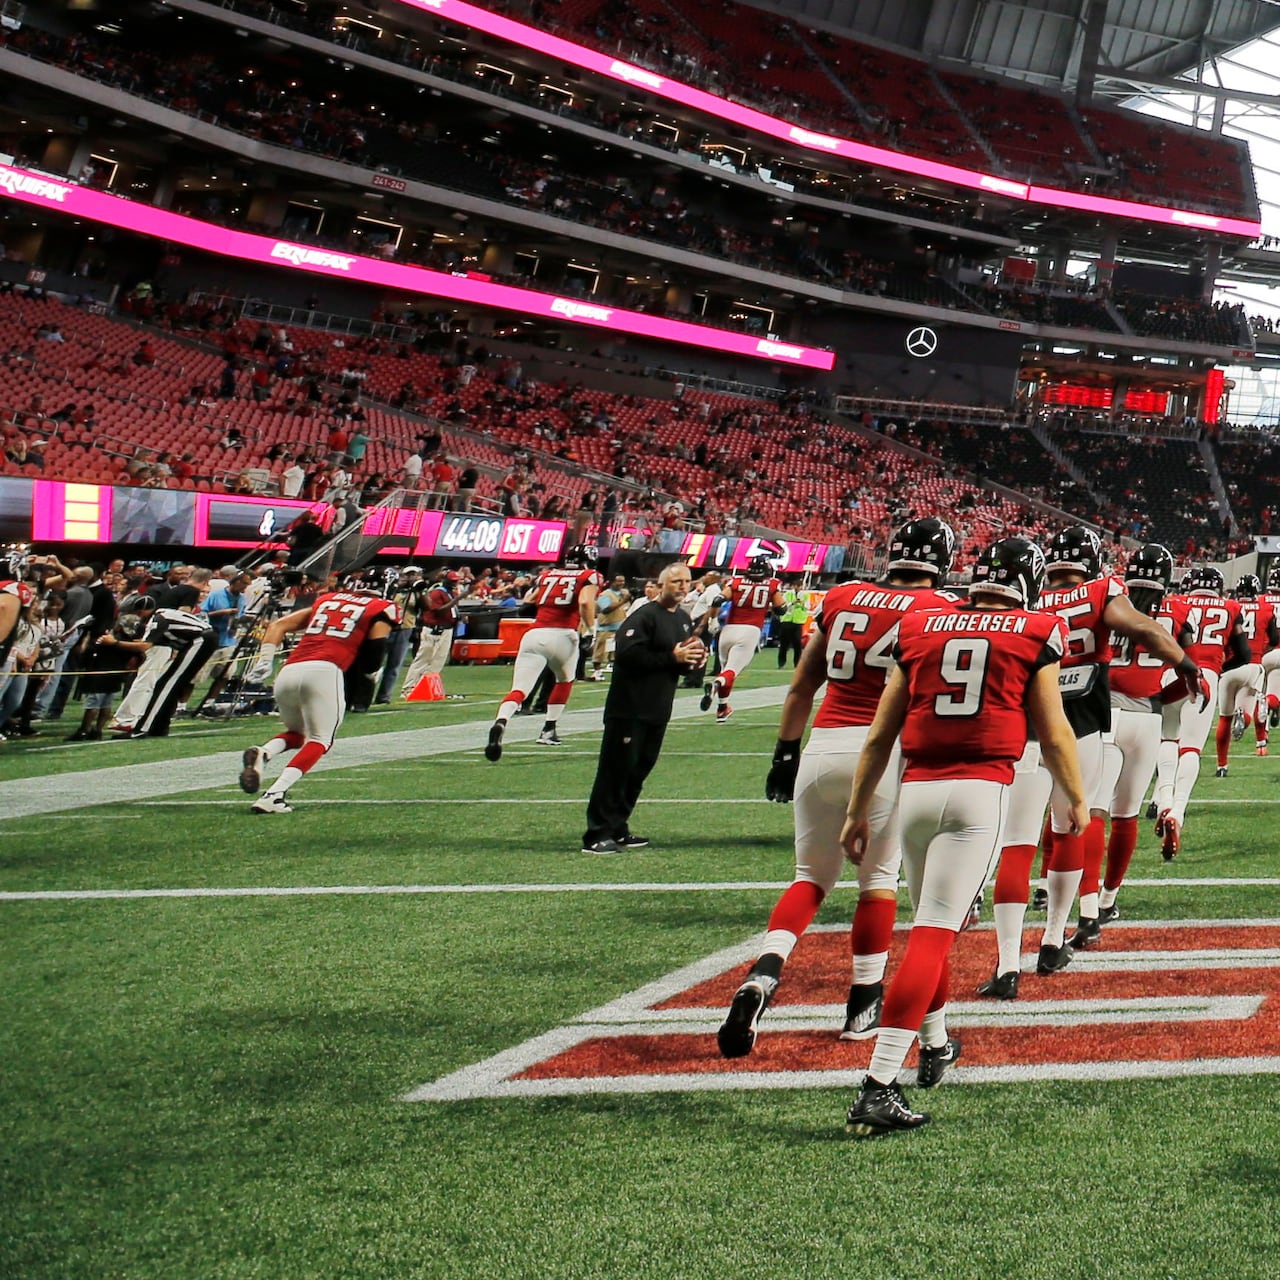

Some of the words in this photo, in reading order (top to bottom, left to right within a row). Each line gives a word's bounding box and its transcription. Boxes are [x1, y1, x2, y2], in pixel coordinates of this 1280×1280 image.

[373, 176, 406, 190] 241-242
[271, 241, 356, 271] EQUIFAX
[259, 509, 274, 536] &
[442, 519, 499, 552] 44:08
[504, 524, 534, 553] 1ST
[538, 530, 561, 552] QTR
[714, 537, 728, 567] 0
[903, 548, 921, 558] 64
[1053, 550, 1070, 559] 95
[989, 571, 997, 582] 9
[539, 577, 577, 605] 73
[736, 585, 770, 609] 70
[851, 590, 916, 612] HARLOW
[1187, 598, 1224, 607] PERKINS
[306, 601, 366, 638] 63
[923, 615, 1027, 634] TORGERSEN
[1056, 603, 1096, 657] 5
[825, 611, 900, 685] 64
[934, 638, 990, 716] 9
